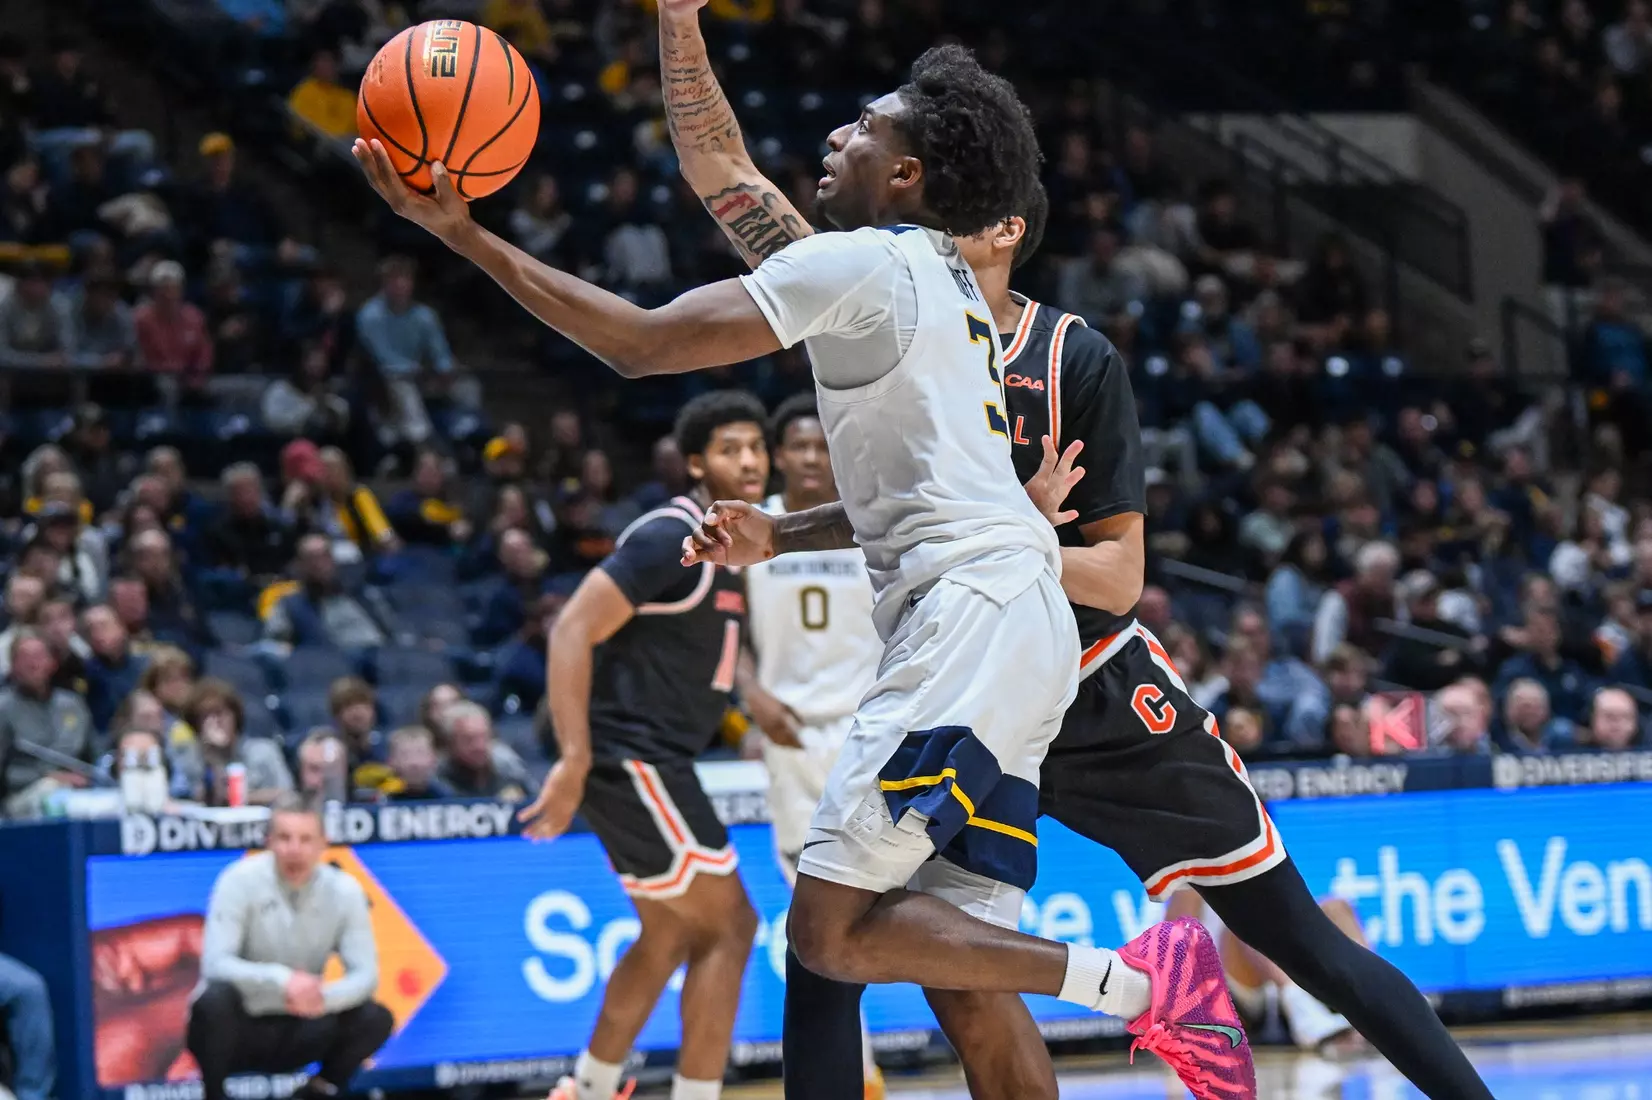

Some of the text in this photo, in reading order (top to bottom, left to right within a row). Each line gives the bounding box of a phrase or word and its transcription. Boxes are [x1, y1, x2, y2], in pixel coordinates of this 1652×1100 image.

[431, 20, 462, 78] ELITE
[1005, 373, 1045, 391] CAA
[1131, 683, 1177, 734] C
[378, 803, 515, 841] ENERGY
